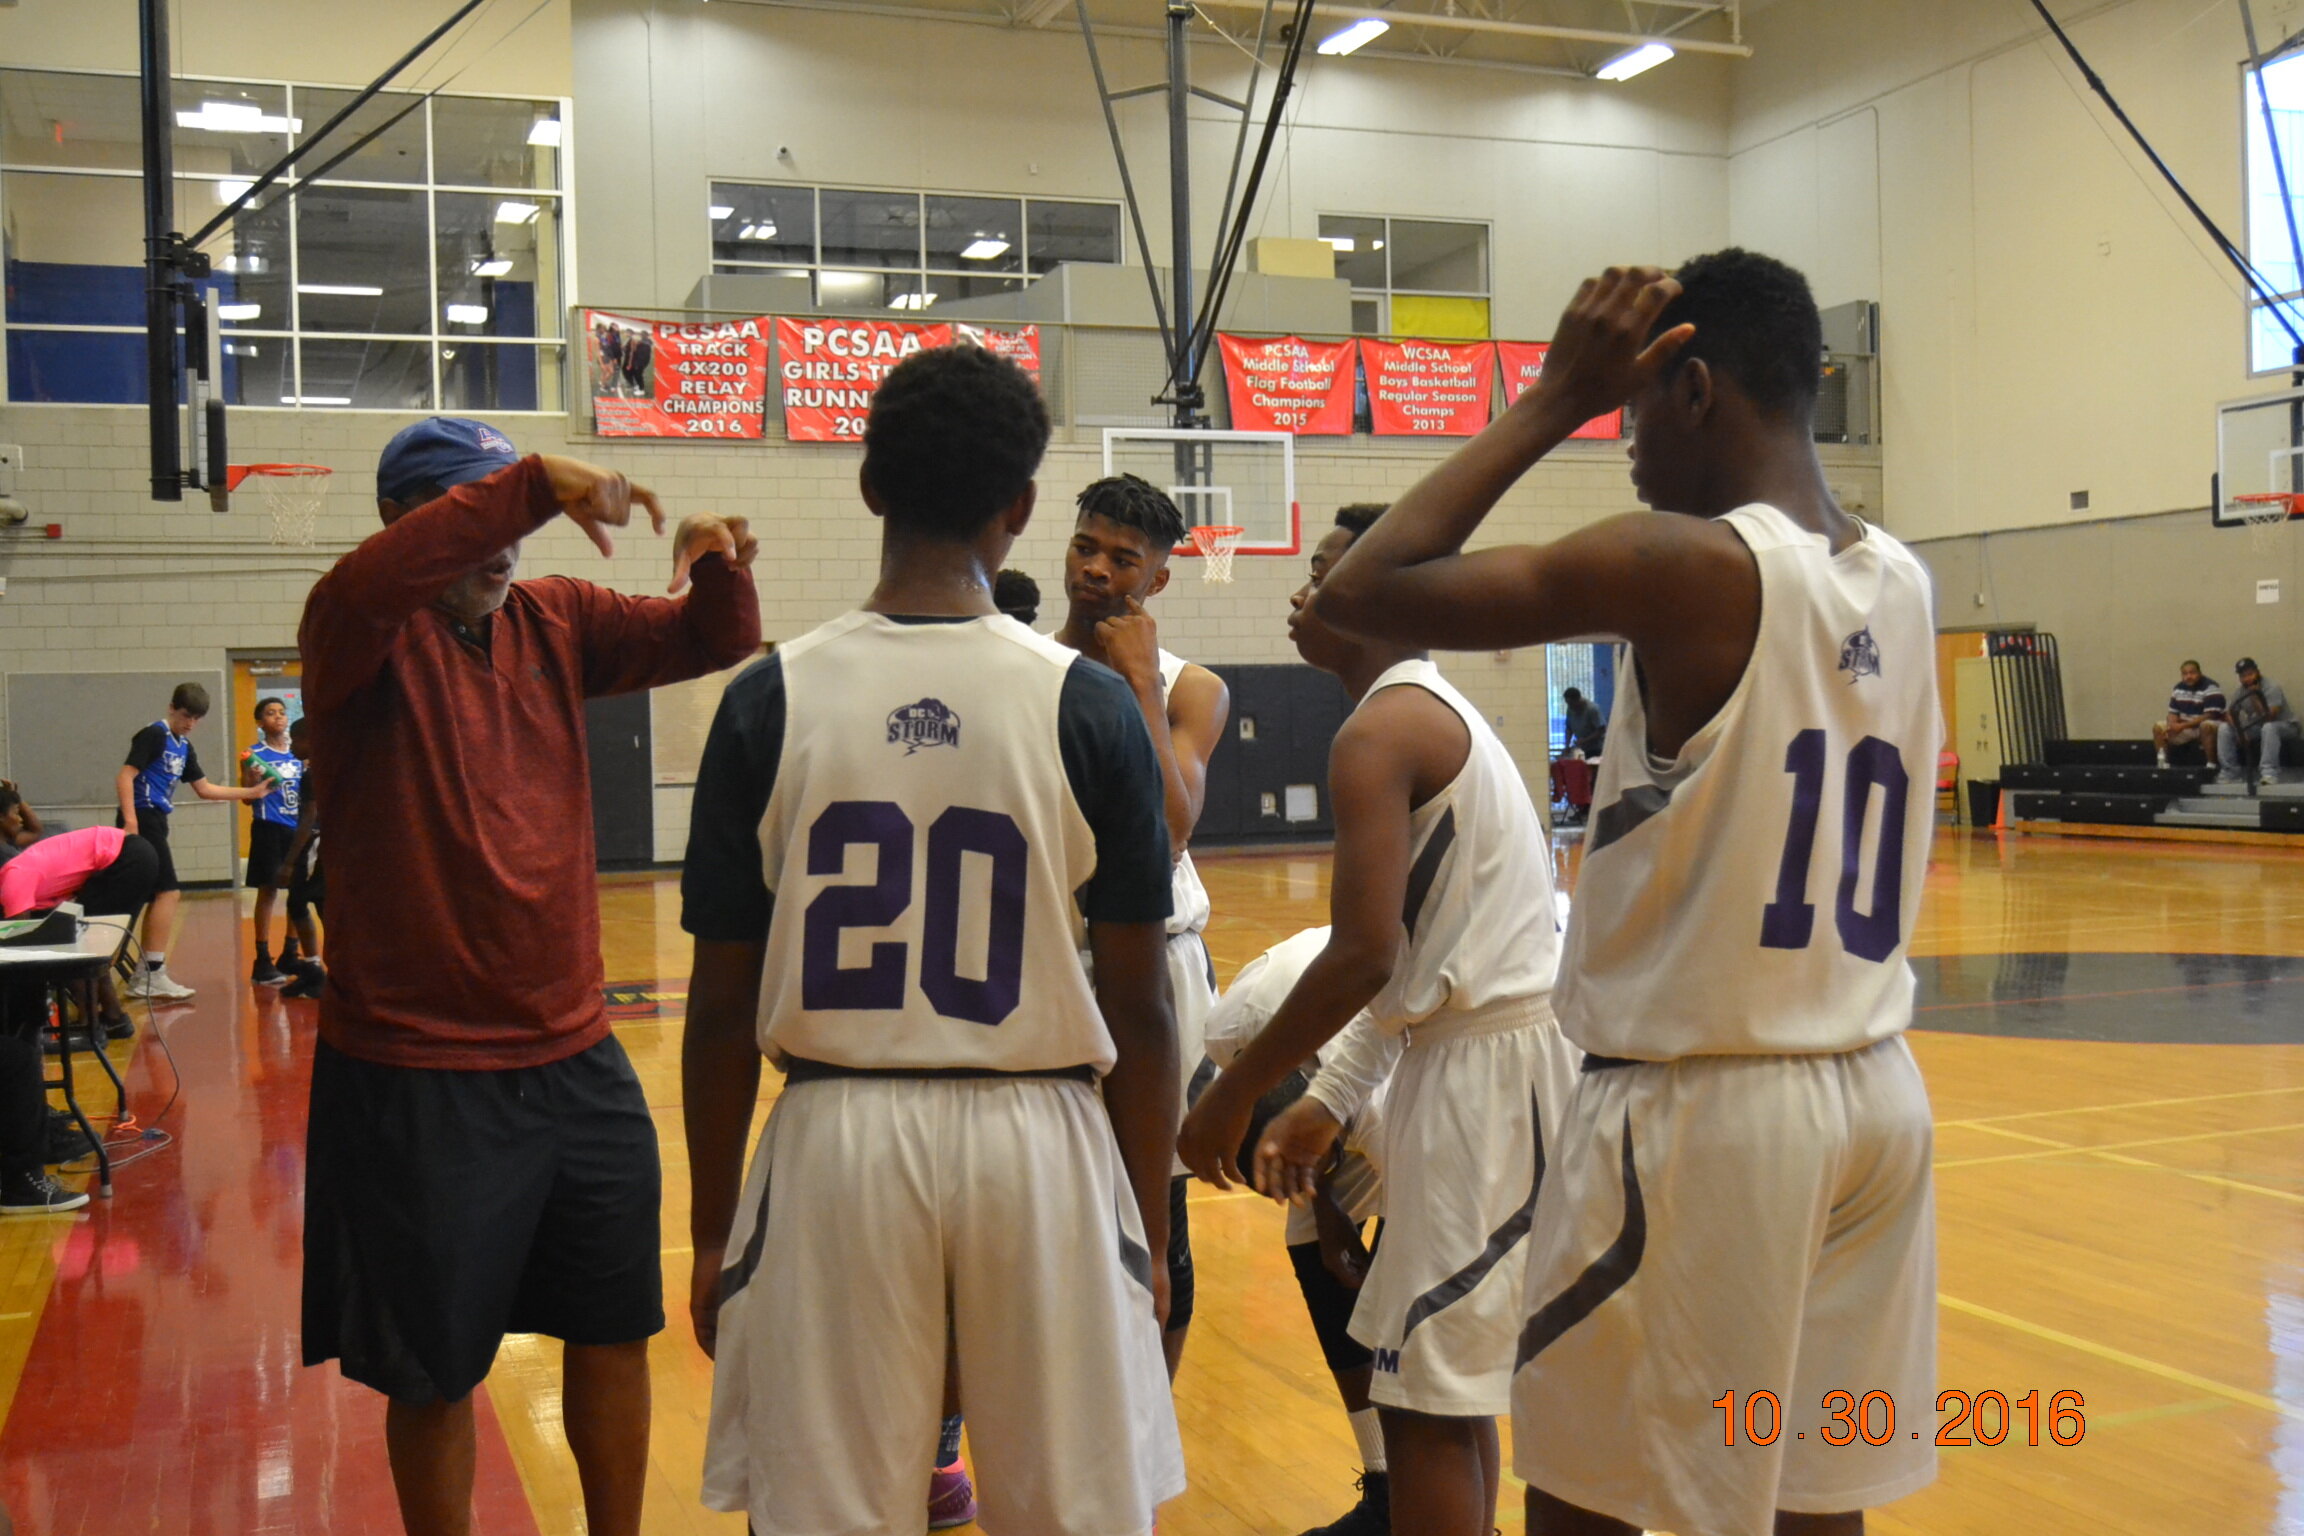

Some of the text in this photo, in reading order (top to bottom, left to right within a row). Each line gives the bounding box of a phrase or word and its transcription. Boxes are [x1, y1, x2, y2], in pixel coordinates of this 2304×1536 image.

[659, 320, 761, 340] PCSAA
[677, 343, 749, 357] TRACK
[803, 327, 922, 358] PCSAA
[1264, 344, 1309, 358] PCSAA
[1402, 346, 1451, 360] WCSAA
[678, 361, 748, 376] 4X200
[783, 361, 860, 381] GIRLS
[1243, 358, 1335, 373] Middle School
[1384, 361, 1472, 374] Middle School
[681, 380, 749, 395] RELAY
[1247, 375, 1332, 391] Flag Football
[1379, 375, 1477, 388] Boys Basketball
[786, 388, 869, 409] RUNN
[1252, 393, 1326, 410] Champions
[1379, 389, 1477, 403] Regular Season
[663, 399, 765, 414] CHAMPIONS
[1402, 404, 1455, 418] Champs
[686, 419, 742, 433] 2016
[834, 416, 867, 436] 20
[1273, 412, 1307, 426] 2015
[1413, 419, 1446, 431] 2013
[886, 719, 959, 748] STORM
[282, 779, 299, 809] 6
[1759, 729, 1909, 964] 10
[802, 801, 1028, 1026] 20
